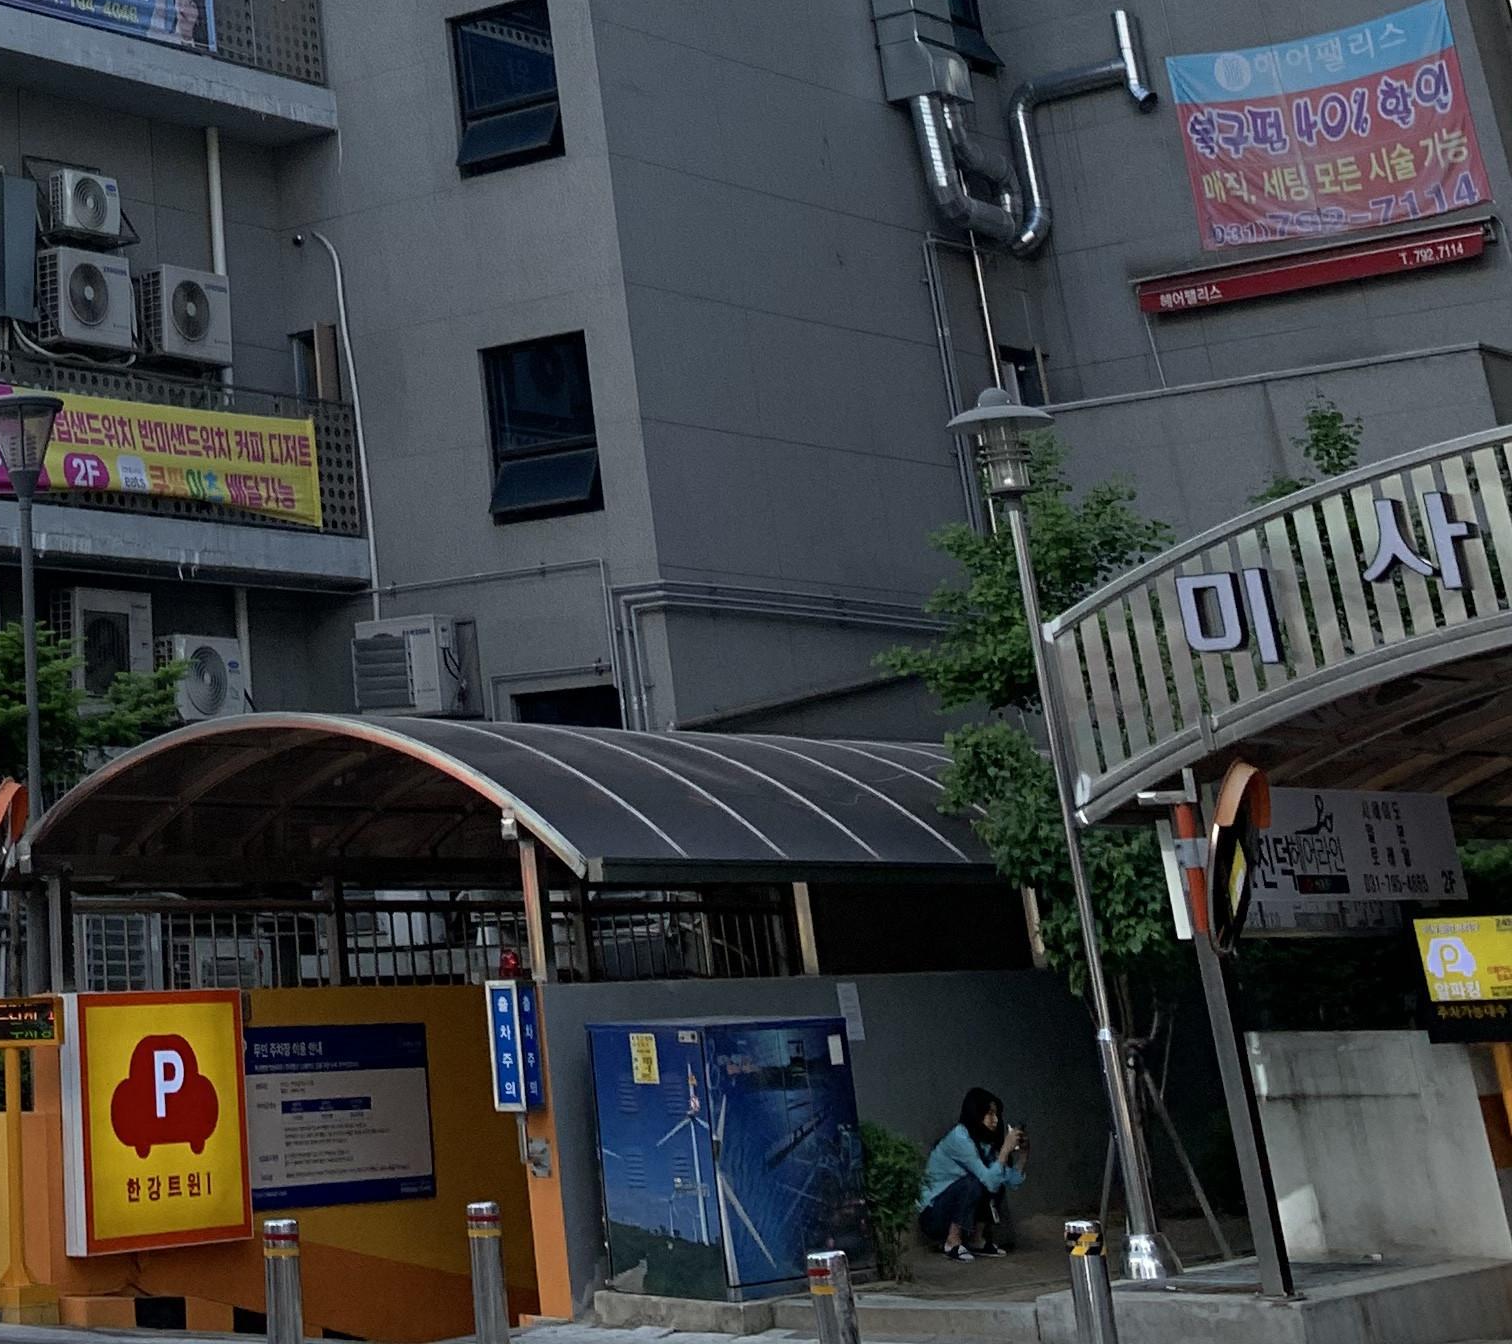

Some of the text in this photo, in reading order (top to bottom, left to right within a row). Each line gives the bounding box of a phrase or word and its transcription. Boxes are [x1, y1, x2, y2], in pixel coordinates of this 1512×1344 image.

[1293, 87, 1372, 147] 40%
[1262, 162, 1310, 203] 세팅
[1314, 157, 1363, 195] 모든
[1369, 141, 1417, 184] 시술
[1419, 128, 1469, 169] 가능
[71, 457, 101, 487] 2F
[138, 418, 233, 461] 반미샌드위치
[235, 429, 266, 465] 커피
[268, 432, 313, 467] 디저트
[1175, 491, 1478, 664] 미사
[269, 1041, 291, 1057] 주차장
[308, 1040, 324, 1057] 안내
[497, 995, 517, 1098] 출차주의
[153, 1049, 186, 1119] P
